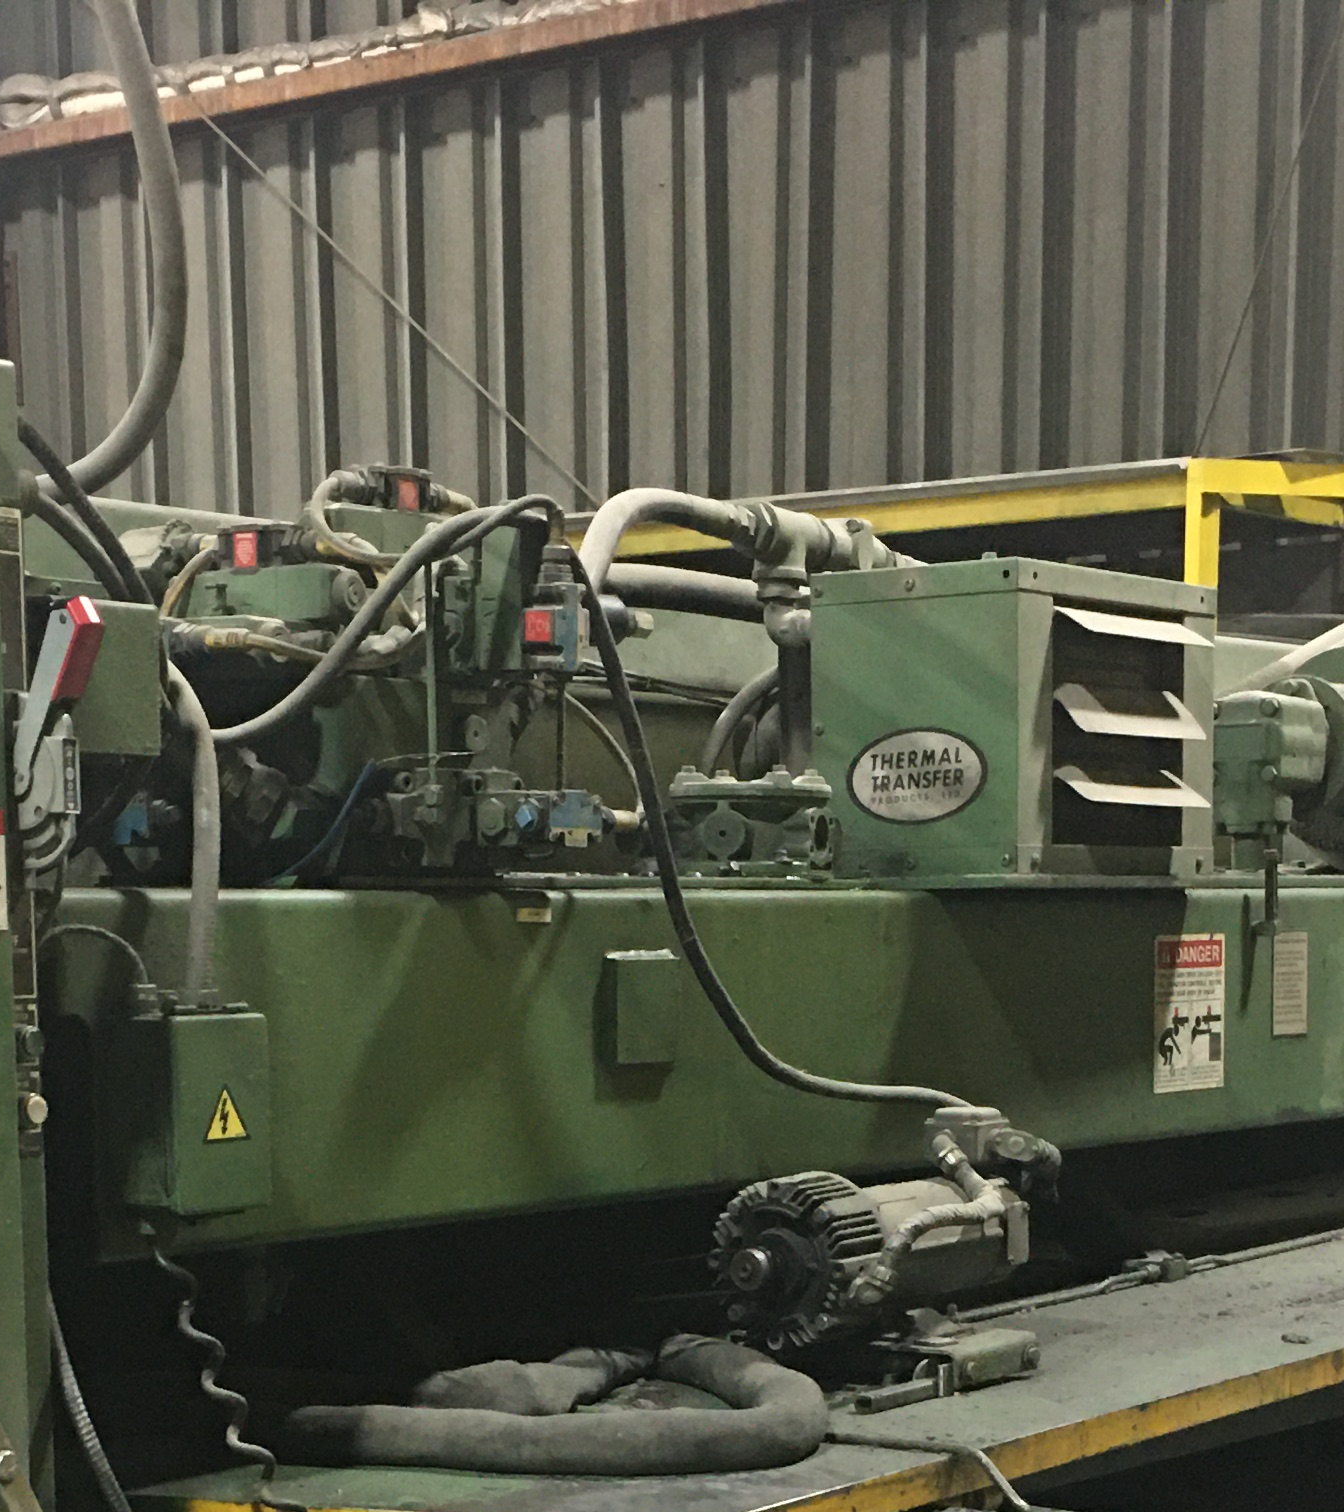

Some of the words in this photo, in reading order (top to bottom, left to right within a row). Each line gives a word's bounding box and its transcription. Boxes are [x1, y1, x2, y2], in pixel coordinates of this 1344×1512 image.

[870, 747, 962, 771] THERMAL
[871, 768, 964, 793] TRANSFER
[1176, 944, 1220, 963] DANGER
